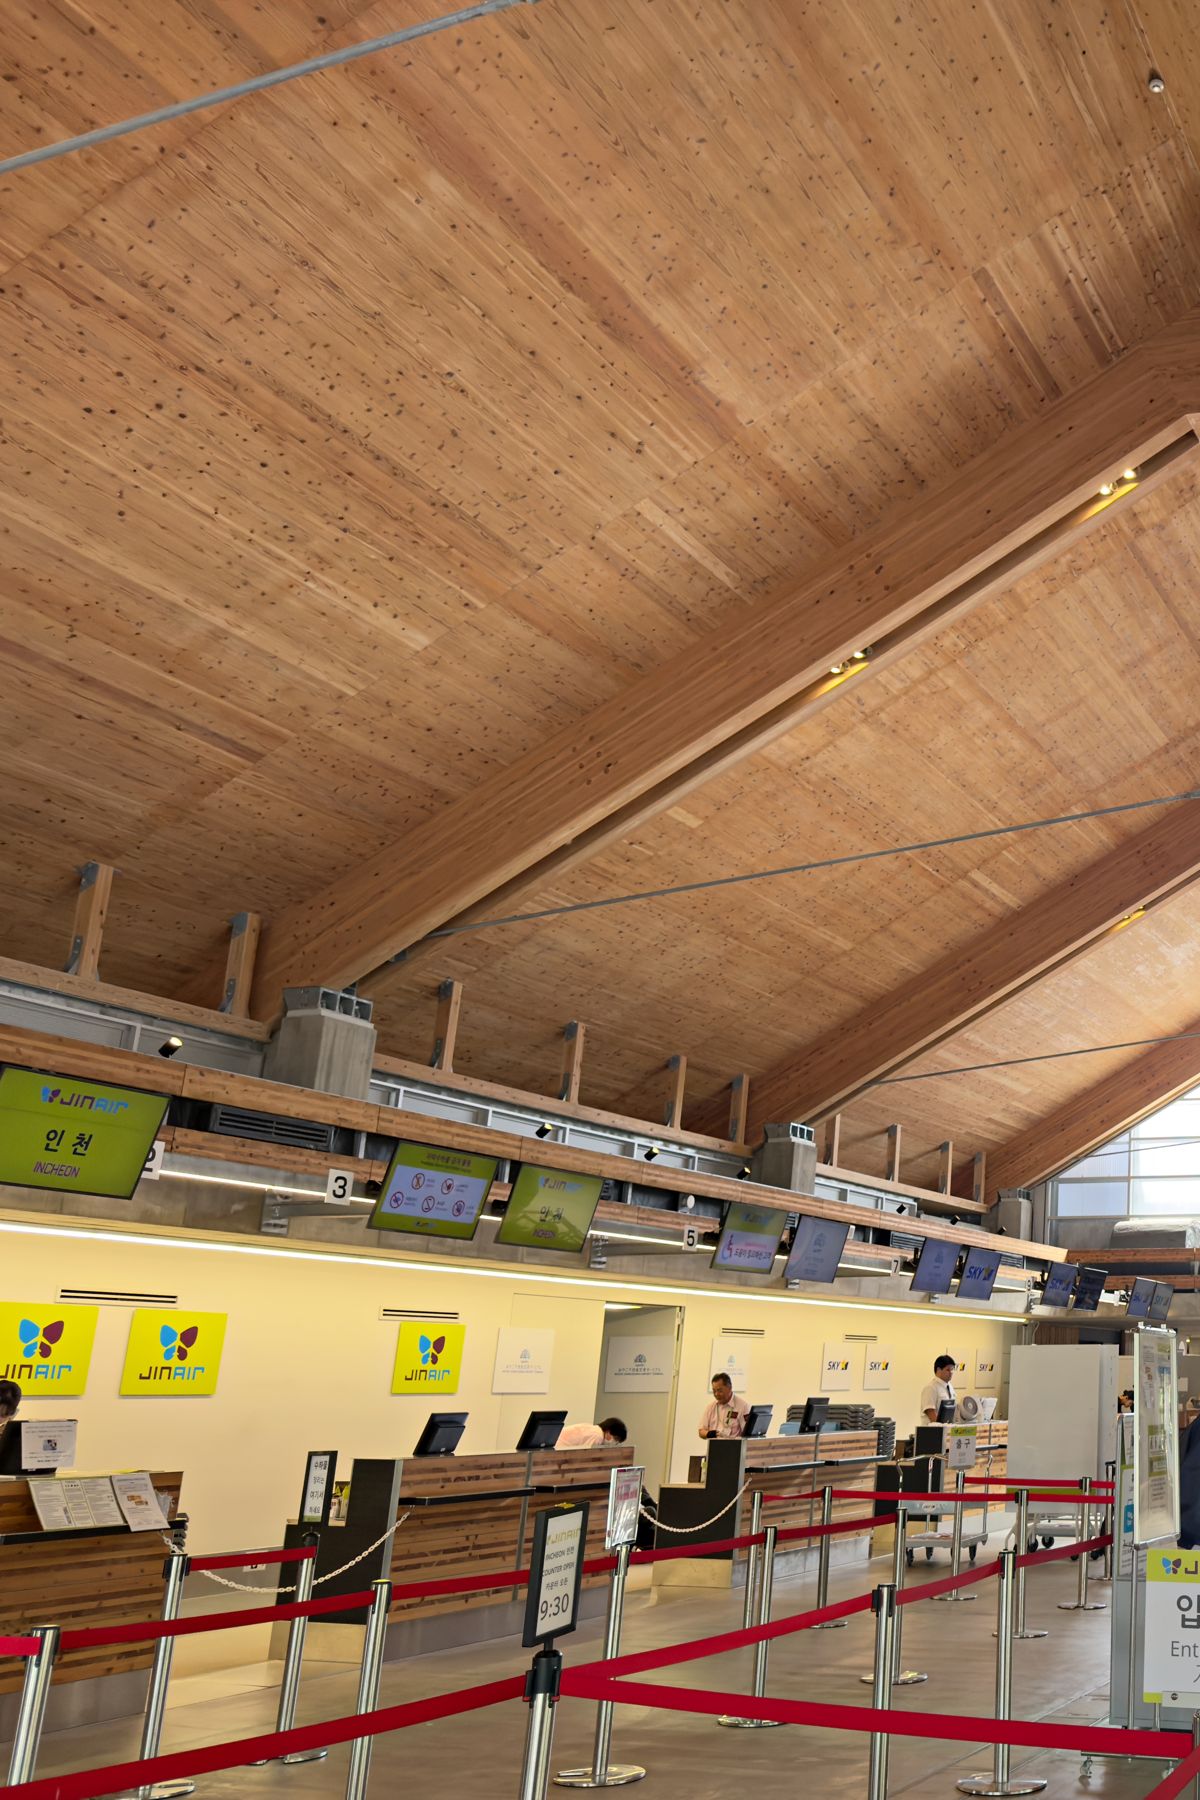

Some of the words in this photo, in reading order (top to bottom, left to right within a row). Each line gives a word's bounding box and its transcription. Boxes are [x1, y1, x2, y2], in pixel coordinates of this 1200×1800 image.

[34, 1161, 80, 1178] INCHEON
[332, 1176, 348, 1199] 3
[686, 1229, 695, 1247] 5
[894, 1260, 899, 1274] 7
[966, 1266, 983, 1280] SKY
[827, 1360, 840, 1370] SKY
[870, 1362, 882, 1371] SKY
[139, 1366, 205, 1380] JINAIR
[404, 1369, 451, 1381] JINAIR
[546, 1549, 565, 1560] INCHEON
[563, 1562, 574, 1571] OPEN
[540, 1593, 570, 1620] 9:30
